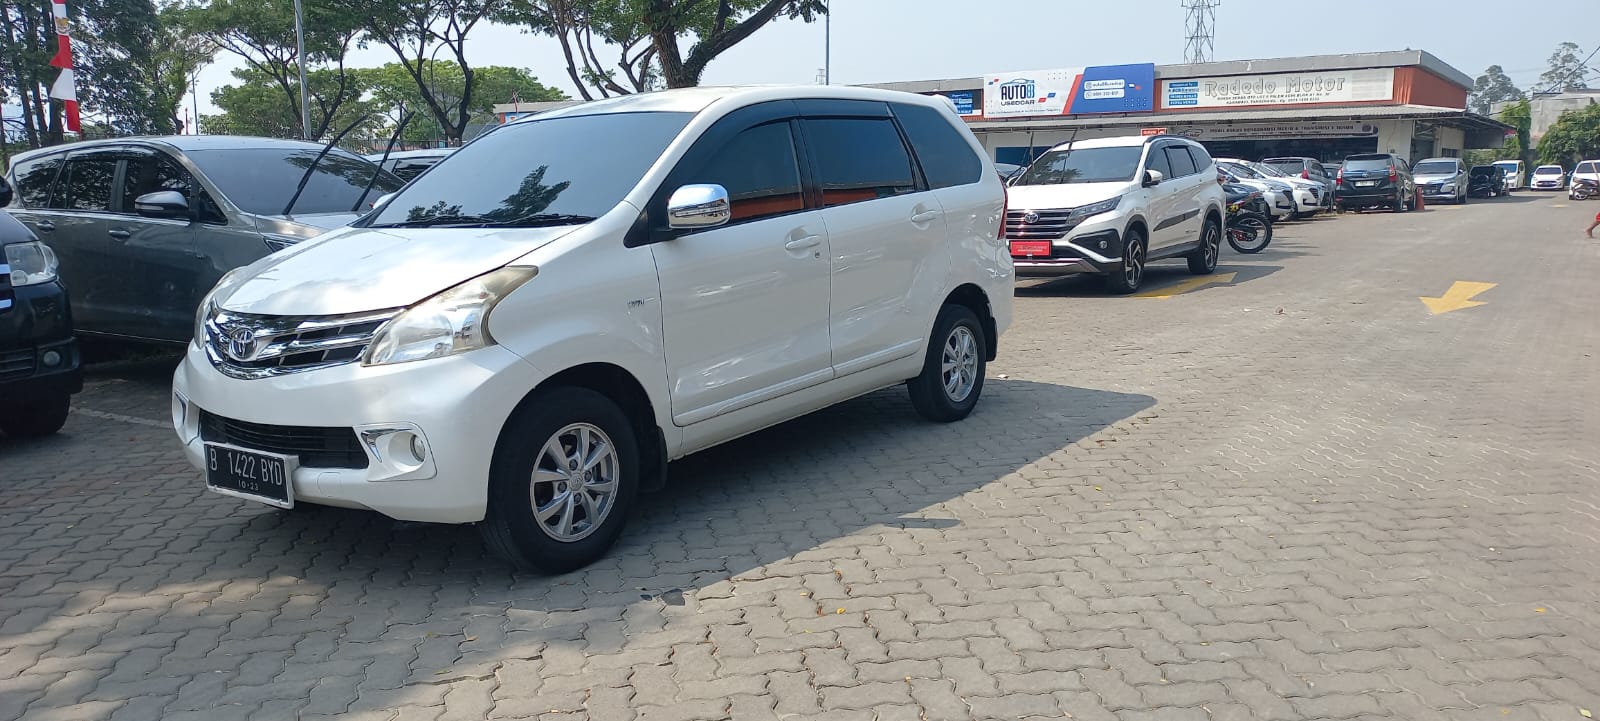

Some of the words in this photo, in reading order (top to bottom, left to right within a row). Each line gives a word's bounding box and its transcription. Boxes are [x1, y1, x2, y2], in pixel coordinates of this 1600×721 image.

[1204, 78, 1276, 97] Radedo
[1285, 76, 1345, 93] Motor
[210, 448, 218, 471] B
[227, 451, 257, 480] 1422
[261, 458, 282, 486] BYD
